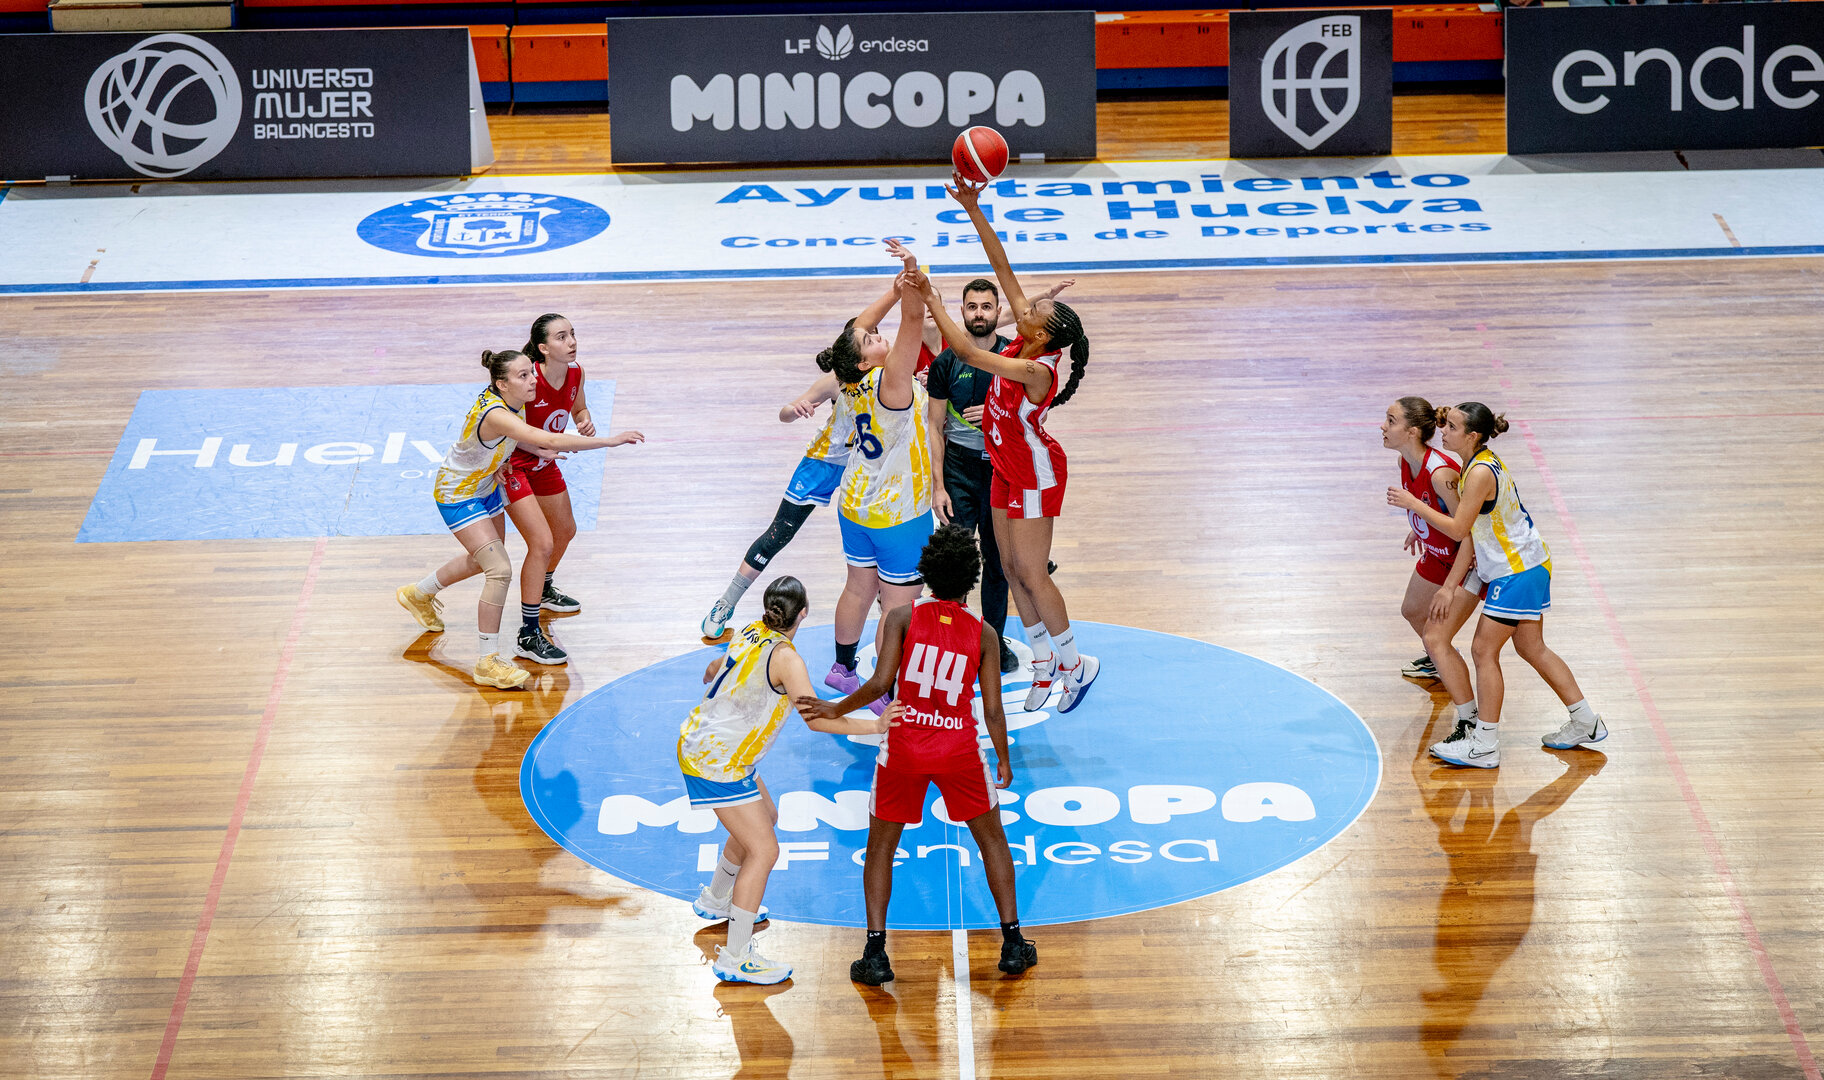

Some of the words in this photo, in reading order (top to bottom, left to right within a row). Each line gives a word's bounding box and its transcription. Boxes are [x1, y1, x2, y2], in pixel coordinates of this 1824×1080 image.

[1321, 24, 1353, 37] FEB
[785, 39, 811, 54] LF
[859, 37, 929, 53] endesa
[252, 68, 374, 89] UNIVERSO
[1552, 25, 1824, 114] ende
[254, 91, 374, 118] MUJER
[670, 70, 1046, 131] MINICOPA
[936, 204, 1065, 224] de
[1107, 196, 1483, 220] Huelva
[1094, 228, 1170, 240] de
[1201, 221, 1493, 239] Deportes
[127, 431, 448, 470] Huelv
[905, 643, 969, 707] 44
[902, 704, 964, 730] embou
